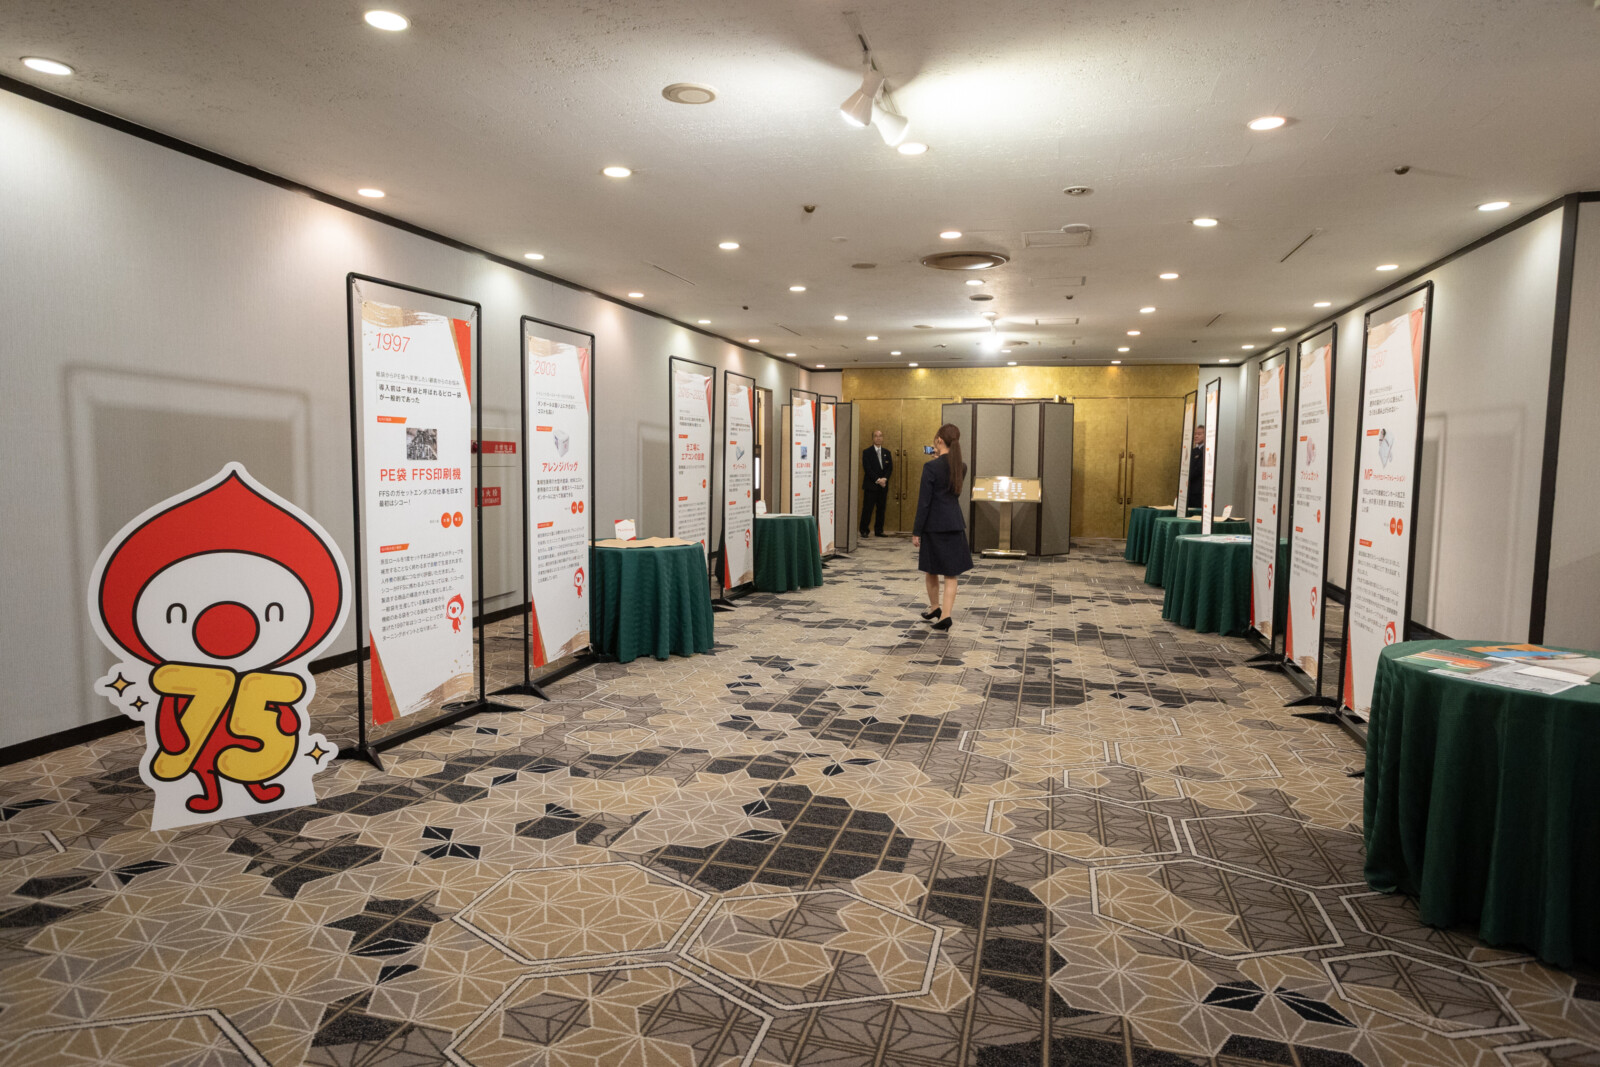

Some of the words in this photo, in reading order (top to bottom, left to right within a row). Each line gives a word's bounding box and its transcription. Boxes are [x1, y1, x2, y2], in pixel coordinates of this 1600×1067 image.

[375, 332, 411, 353] 1997
[534, 360, 557, 376] 2003
[379, 383, 462, 399] 導入前は一般袋と呼ばれるピロー袋
[379, 394, 420, 404] が一般的であった
[380, 467, 407, 482] PE袋
[412, 467, 461, 481] FFS印刷機
[542, 461, 579, 473] アレンジバッグ
[149, 660, 307, 782] 75
